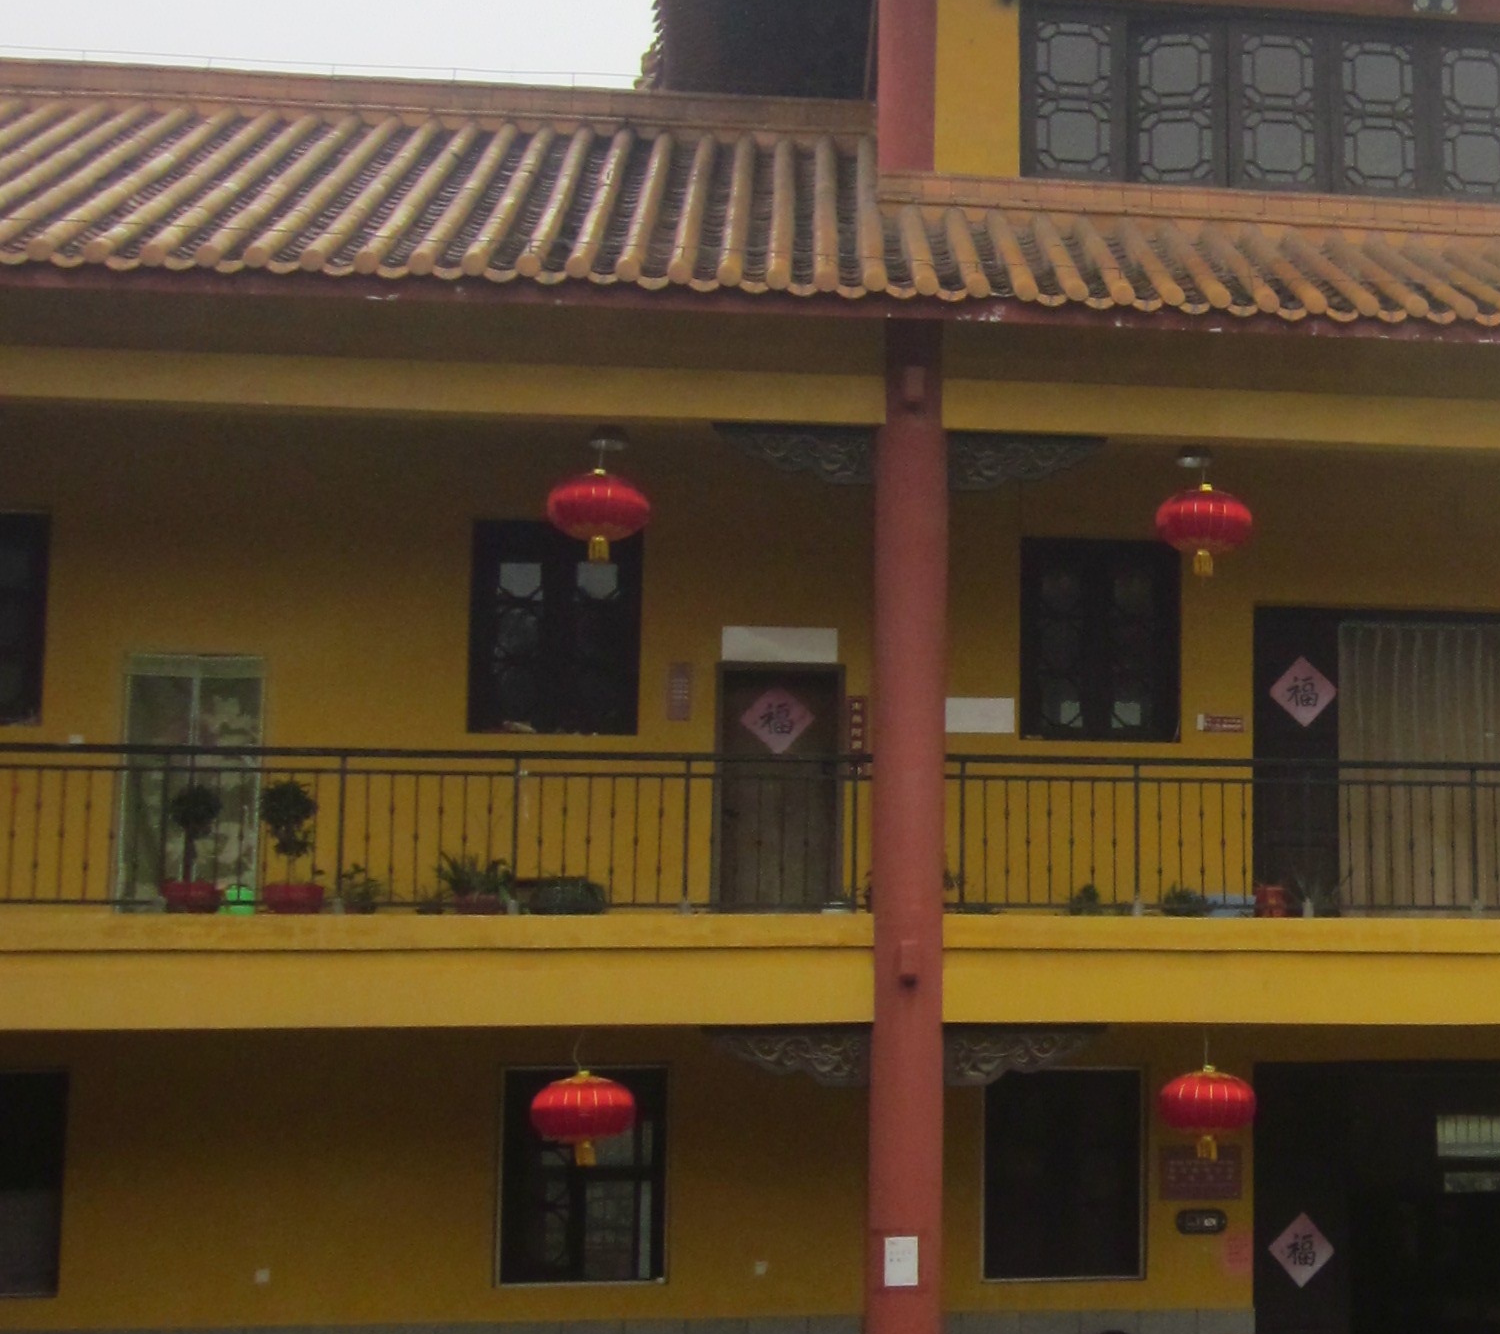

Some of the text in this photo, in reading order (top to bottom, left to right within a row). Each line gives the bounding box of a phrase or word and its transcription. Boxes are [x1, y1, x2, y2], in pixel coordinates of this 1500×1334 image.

[1286, 675, 1319, 707] 福
[759, 702, 794, 735] 福
[1286, 1233, 1316, 1267] 福
